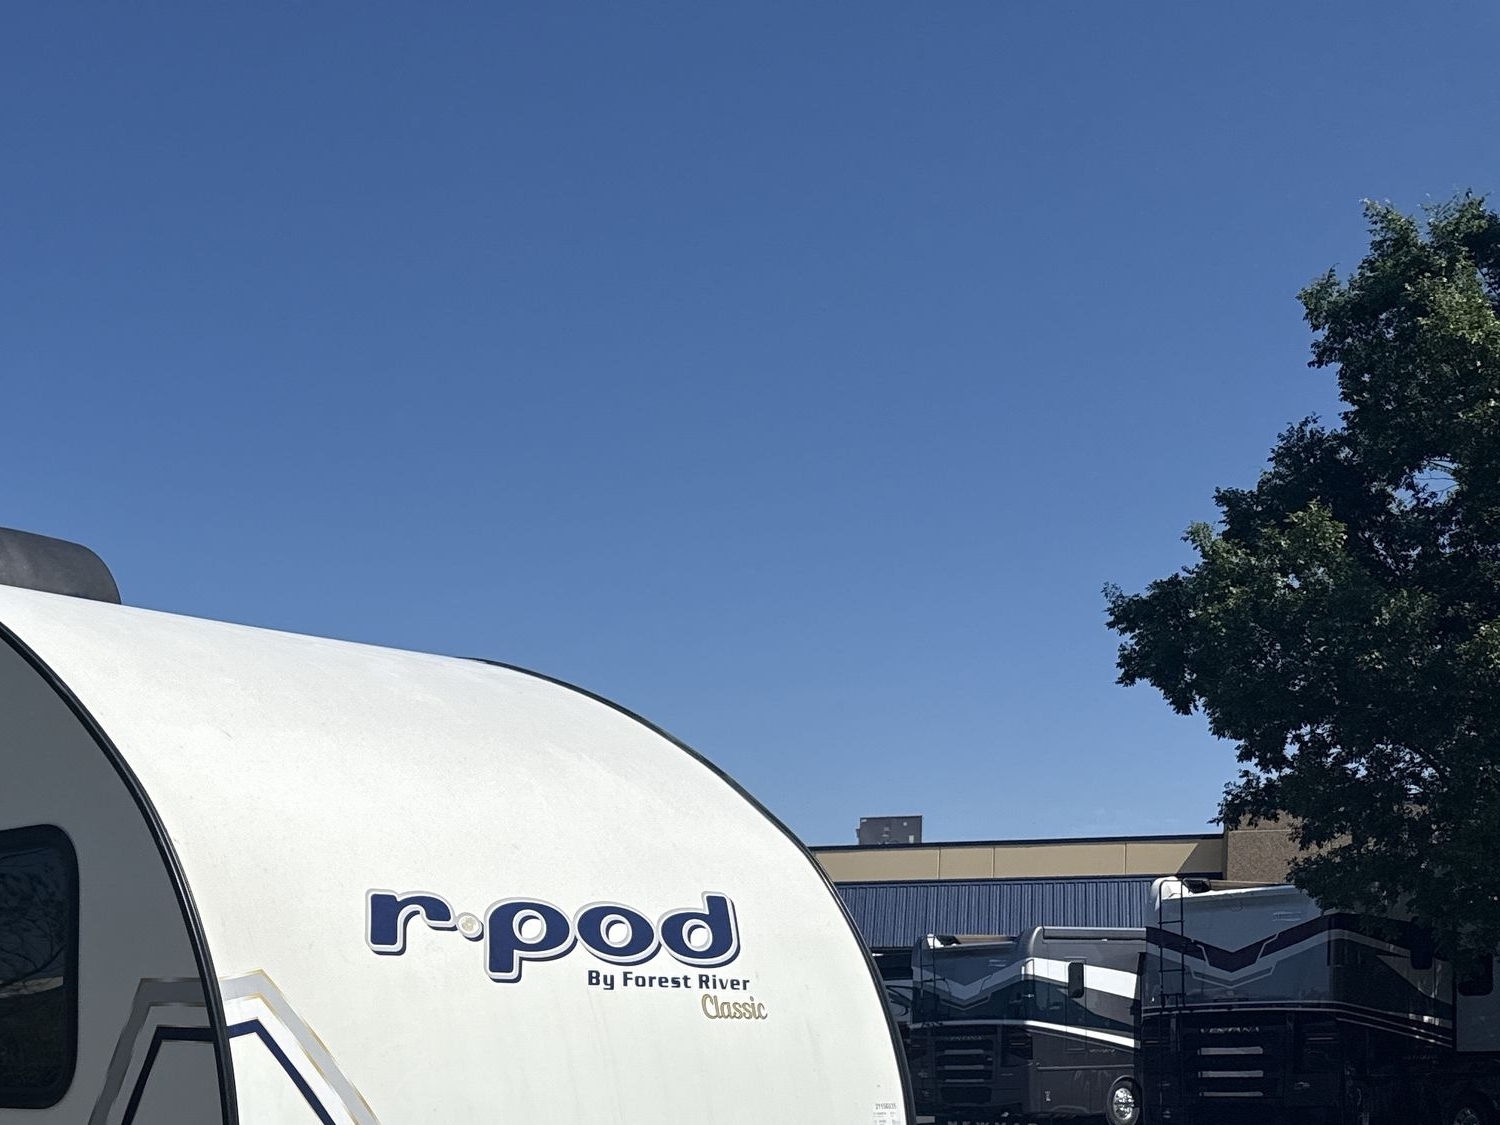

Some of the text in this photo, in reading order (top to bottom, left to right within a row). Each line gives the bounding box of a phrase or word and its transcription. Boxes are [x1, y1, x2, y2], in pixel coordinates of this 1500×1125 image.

[588, 970, 750, 991] By Forest River
[701, 994, 769, 1020] Classic
